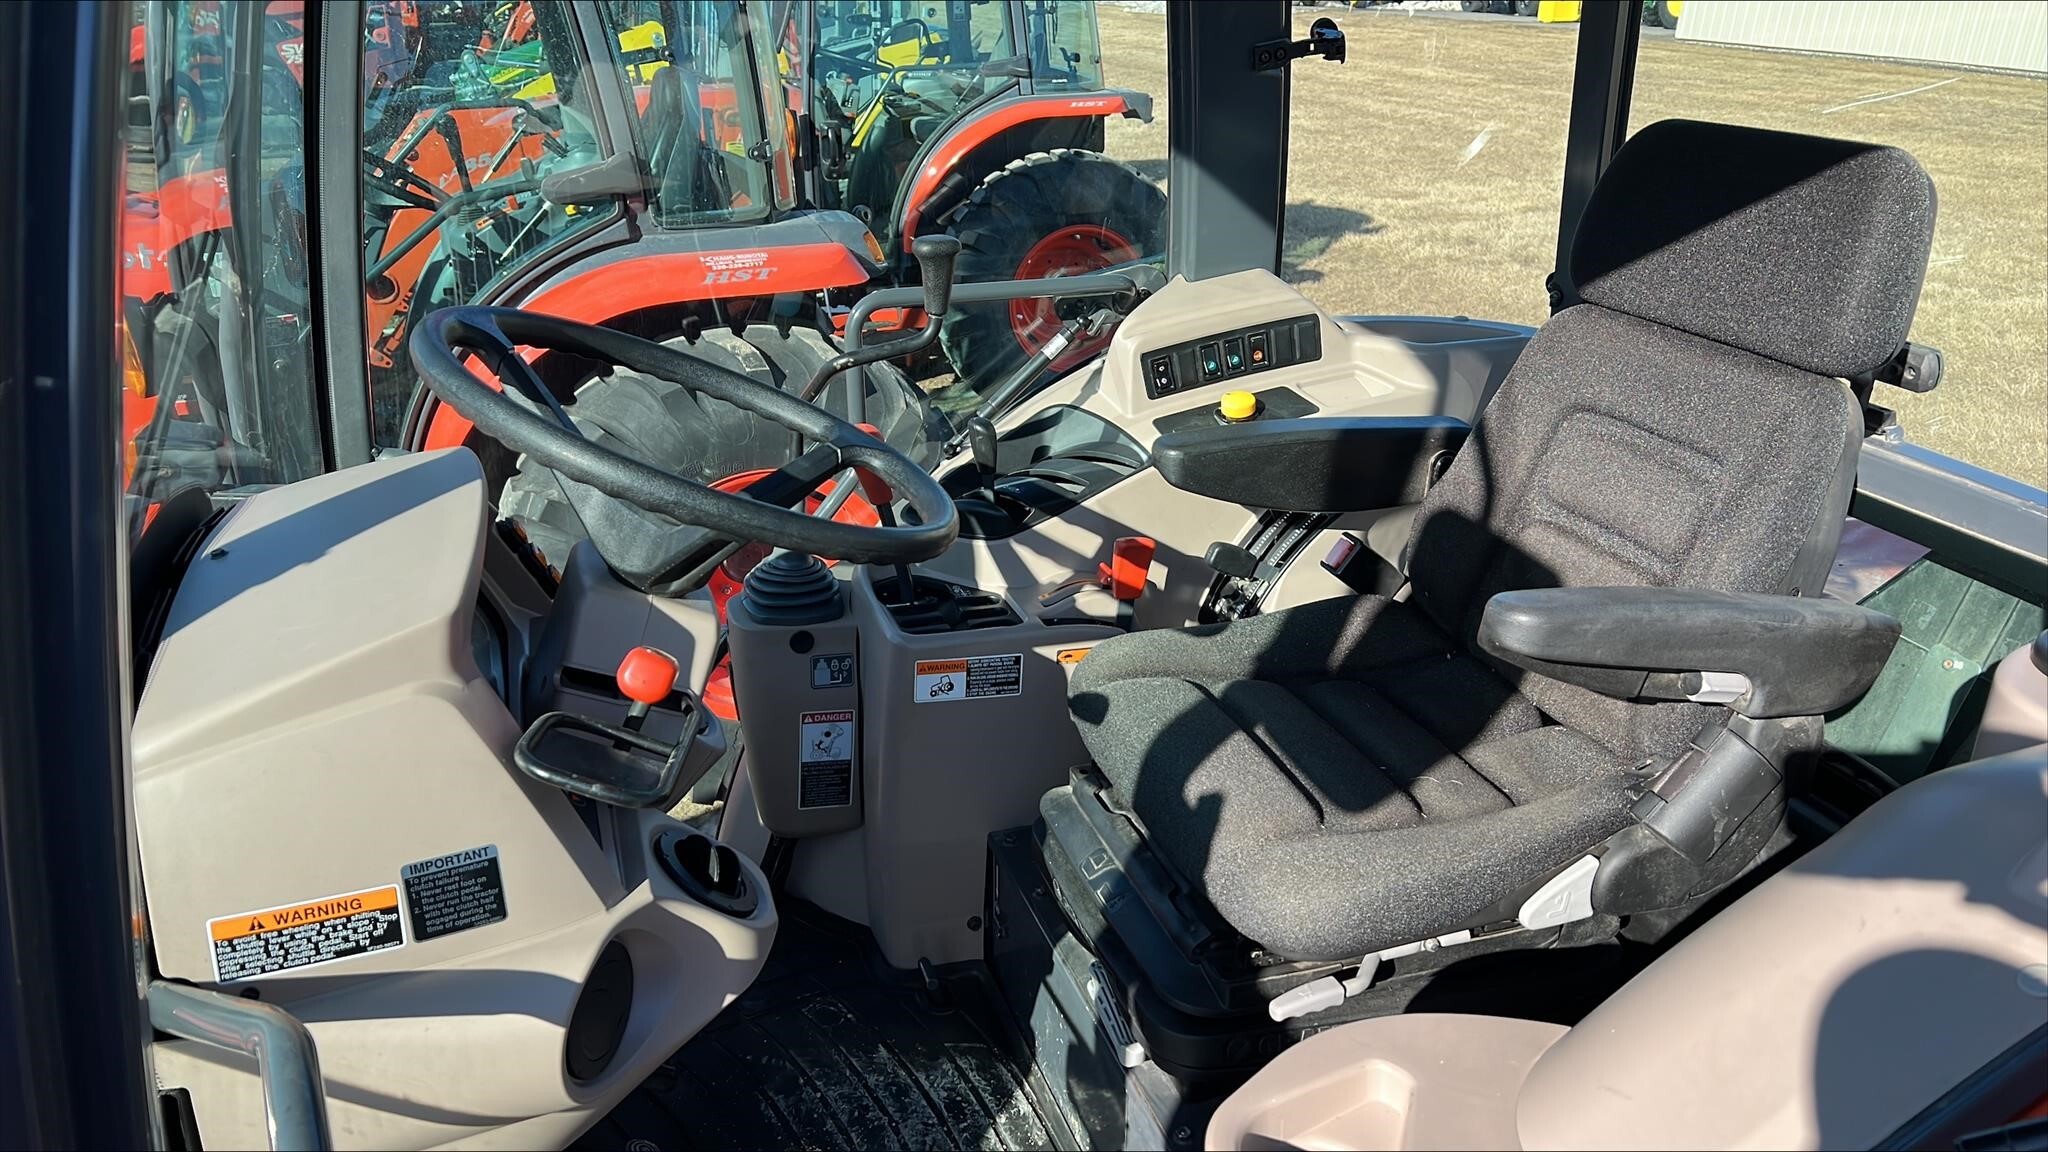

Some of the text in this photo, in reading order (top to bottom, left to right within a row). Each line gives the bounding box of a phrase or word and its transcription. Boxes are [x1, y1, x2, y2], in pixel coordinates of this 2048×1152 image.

[703, 267, 778, 285] HST
[928, 663, 965, 672] WARNING
[814, 713, 852, 722] DANGER
[409, 847, 489, 875] IMPORTANT
[274, 898, 362, 925] WARNING
